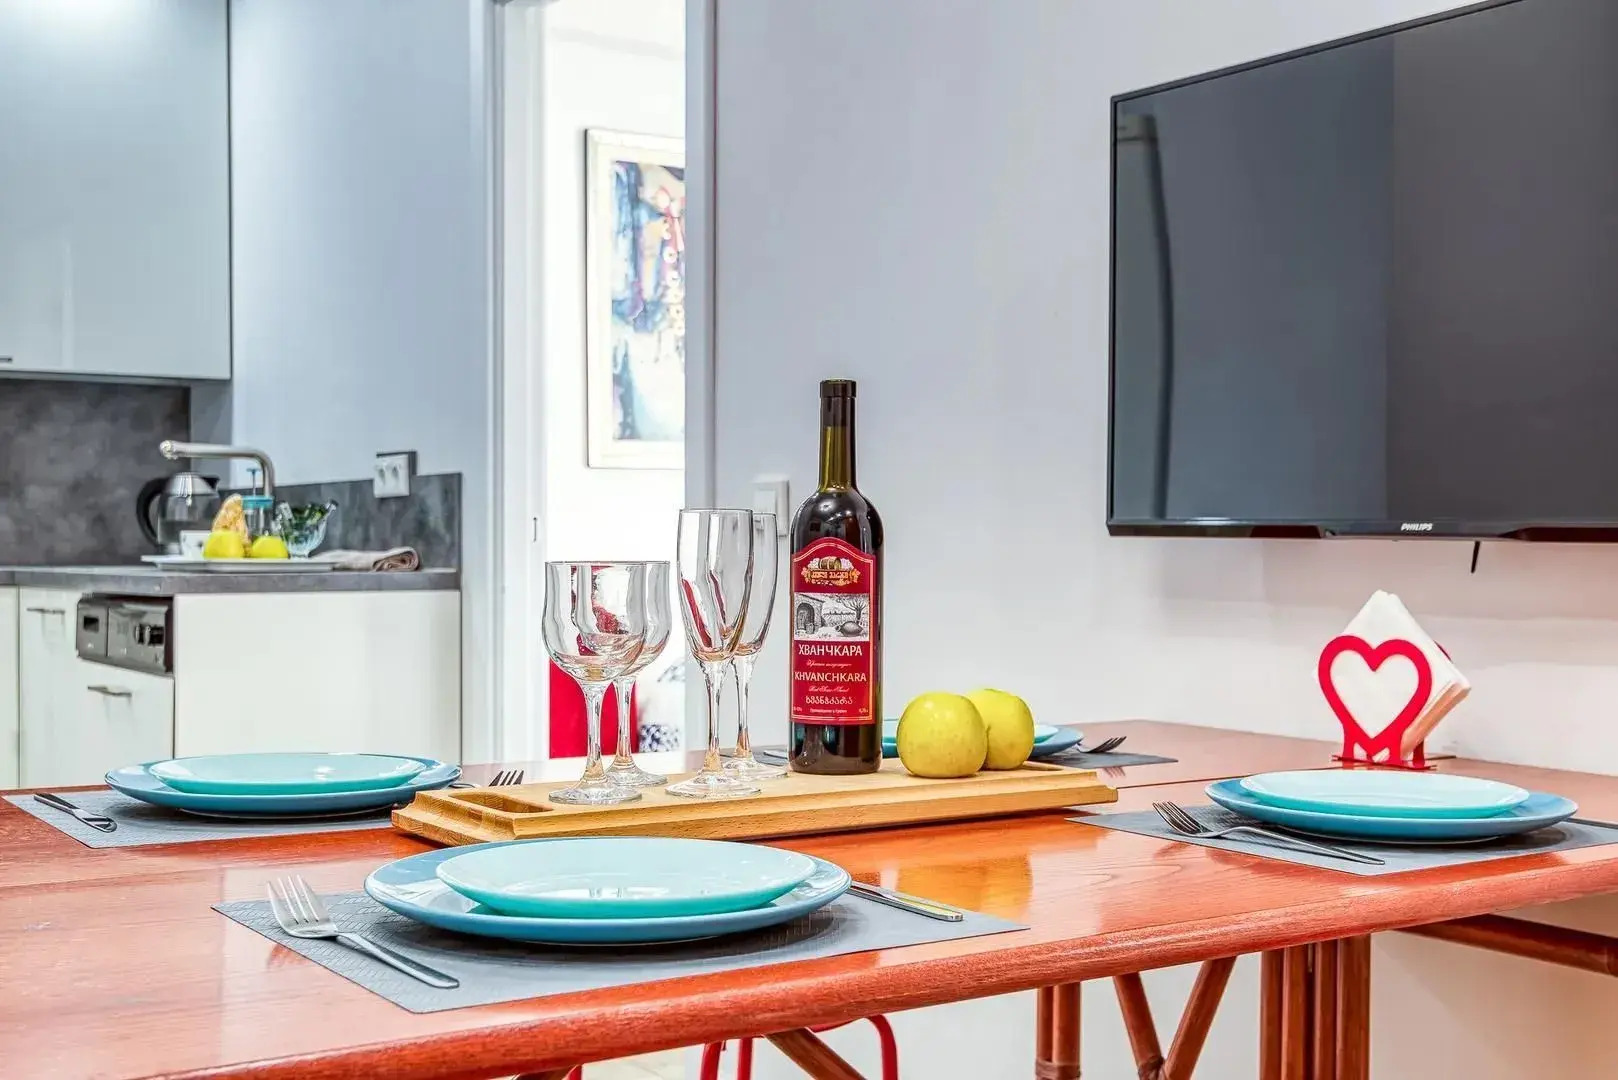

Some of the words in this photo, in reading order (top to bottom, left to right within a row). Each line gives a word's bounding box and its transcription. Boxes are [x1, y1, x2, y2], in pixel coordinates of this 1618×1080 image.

[1400, 522, 1433, 532] PHILIPS
[798, 643, 863, 657] ХВАНЧКАРА
[794, 671, 867, 682] KHVANCHKARA
